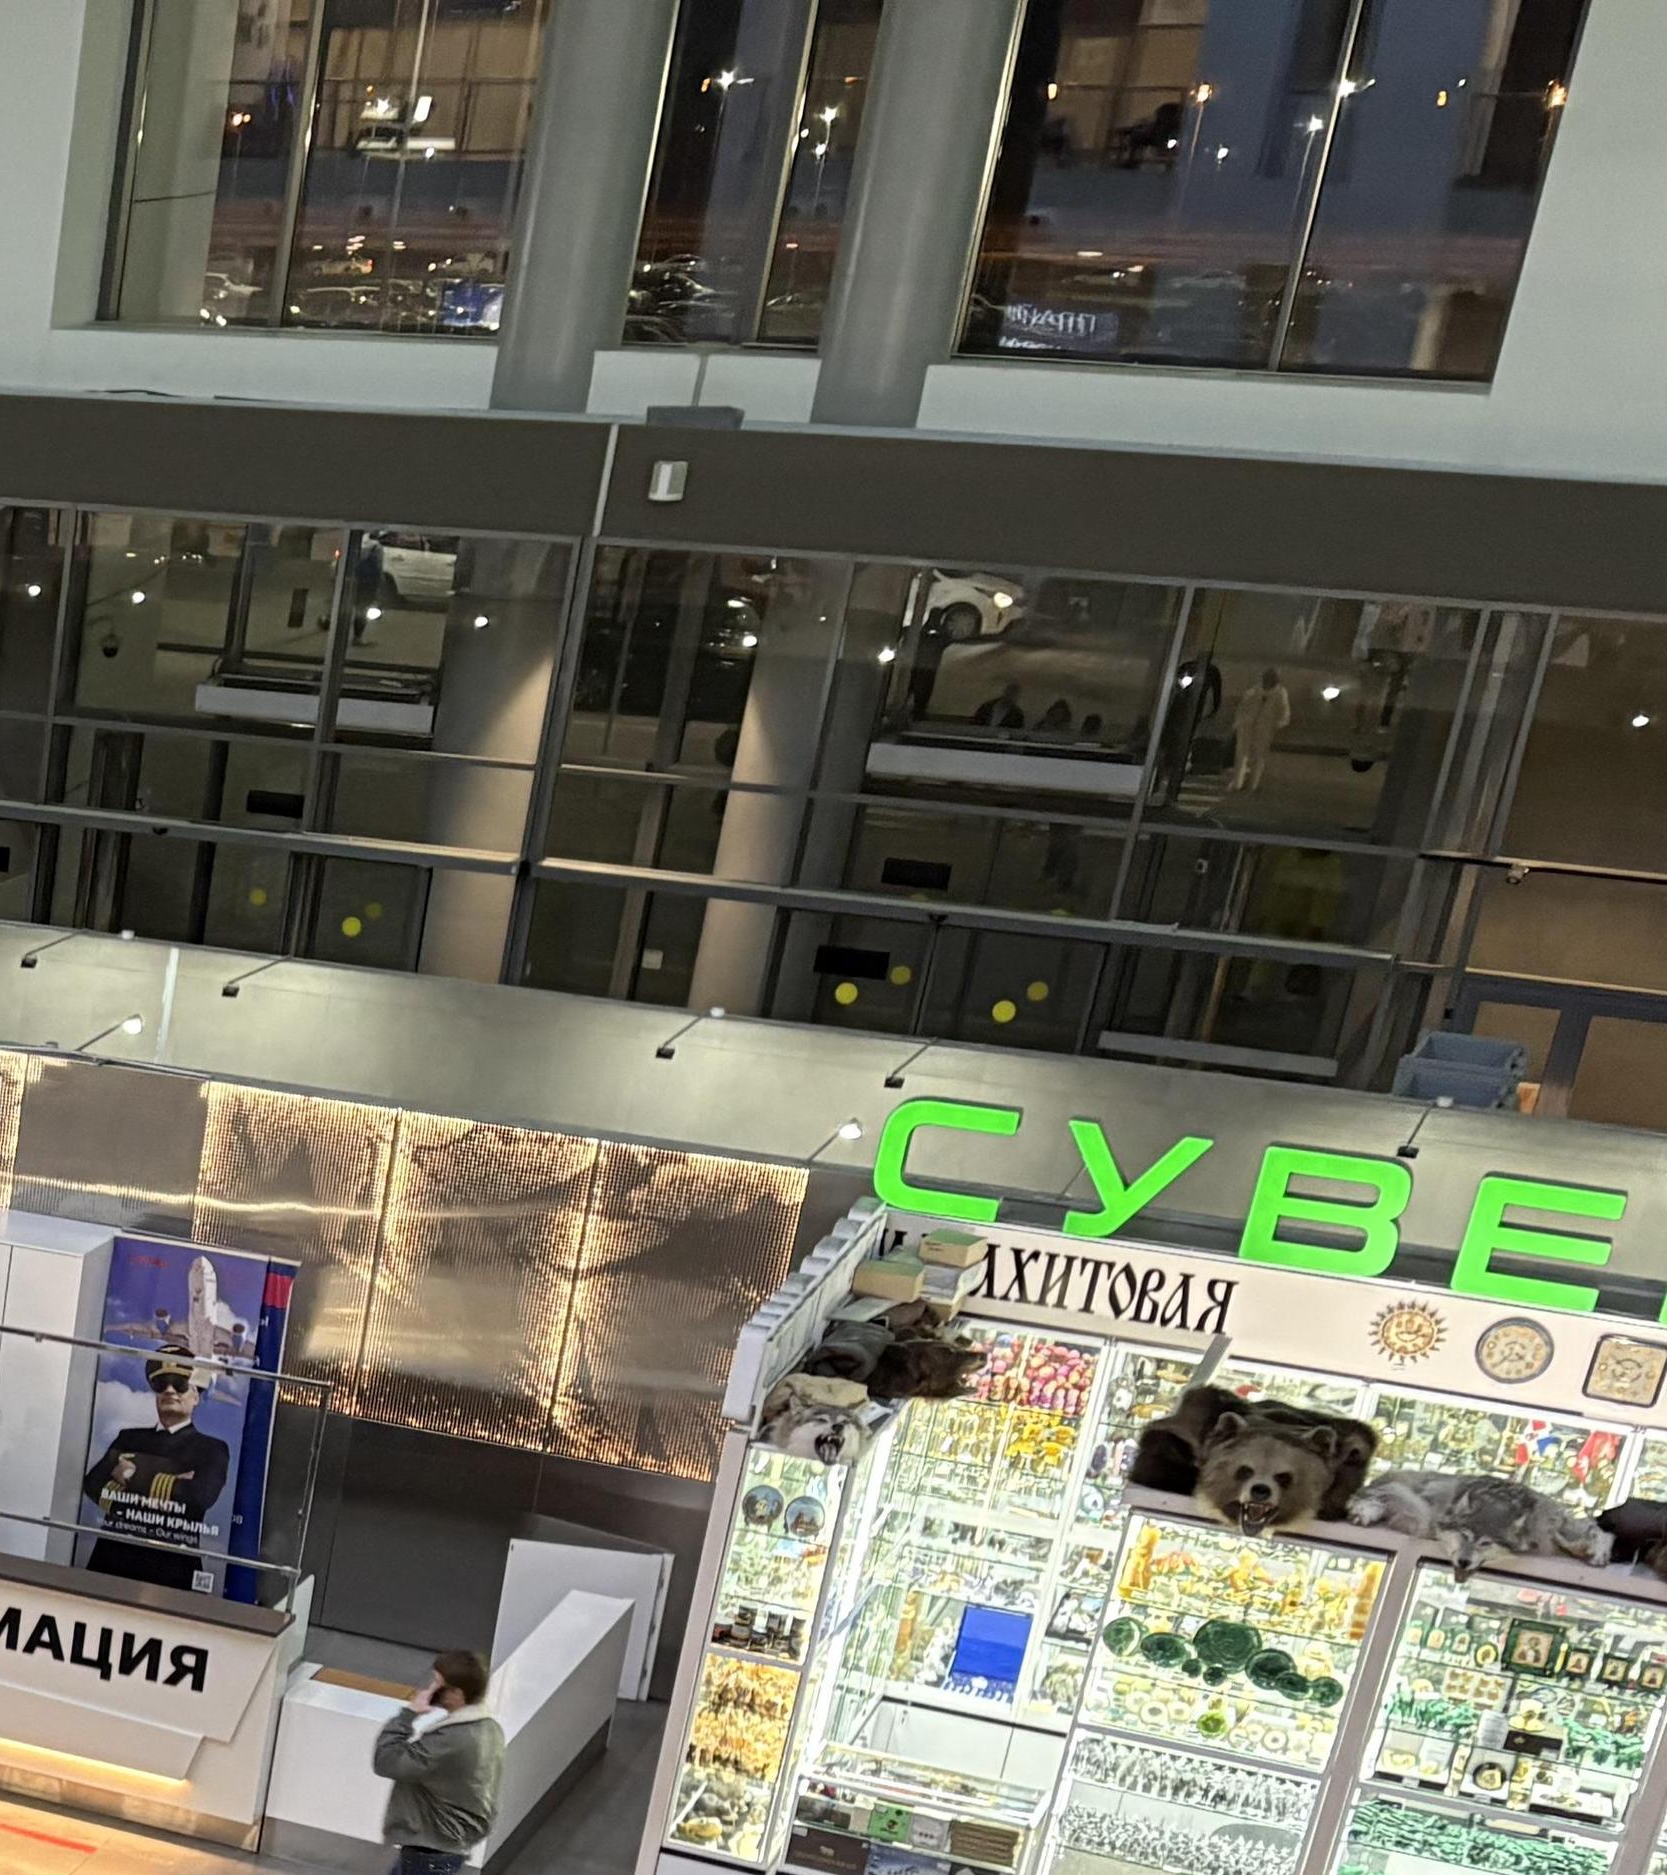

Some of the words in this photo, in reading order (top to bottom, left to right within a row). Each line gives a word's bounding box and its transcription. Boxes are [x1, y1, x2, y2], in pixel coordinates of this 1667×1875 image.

[873, 1098, 1667, 1318] СУВЕ
[879, 1228, 1240, 1336] АХИТОВАЯ
[100, 1487, 139, 1505] ВАШИ
[140, 1494, 187, 1515] МЕЧТЫ
[125, 1507, 166, 1525] НАШИ
[166, 1515, 220, 1538] КРЫЛЬЯ
